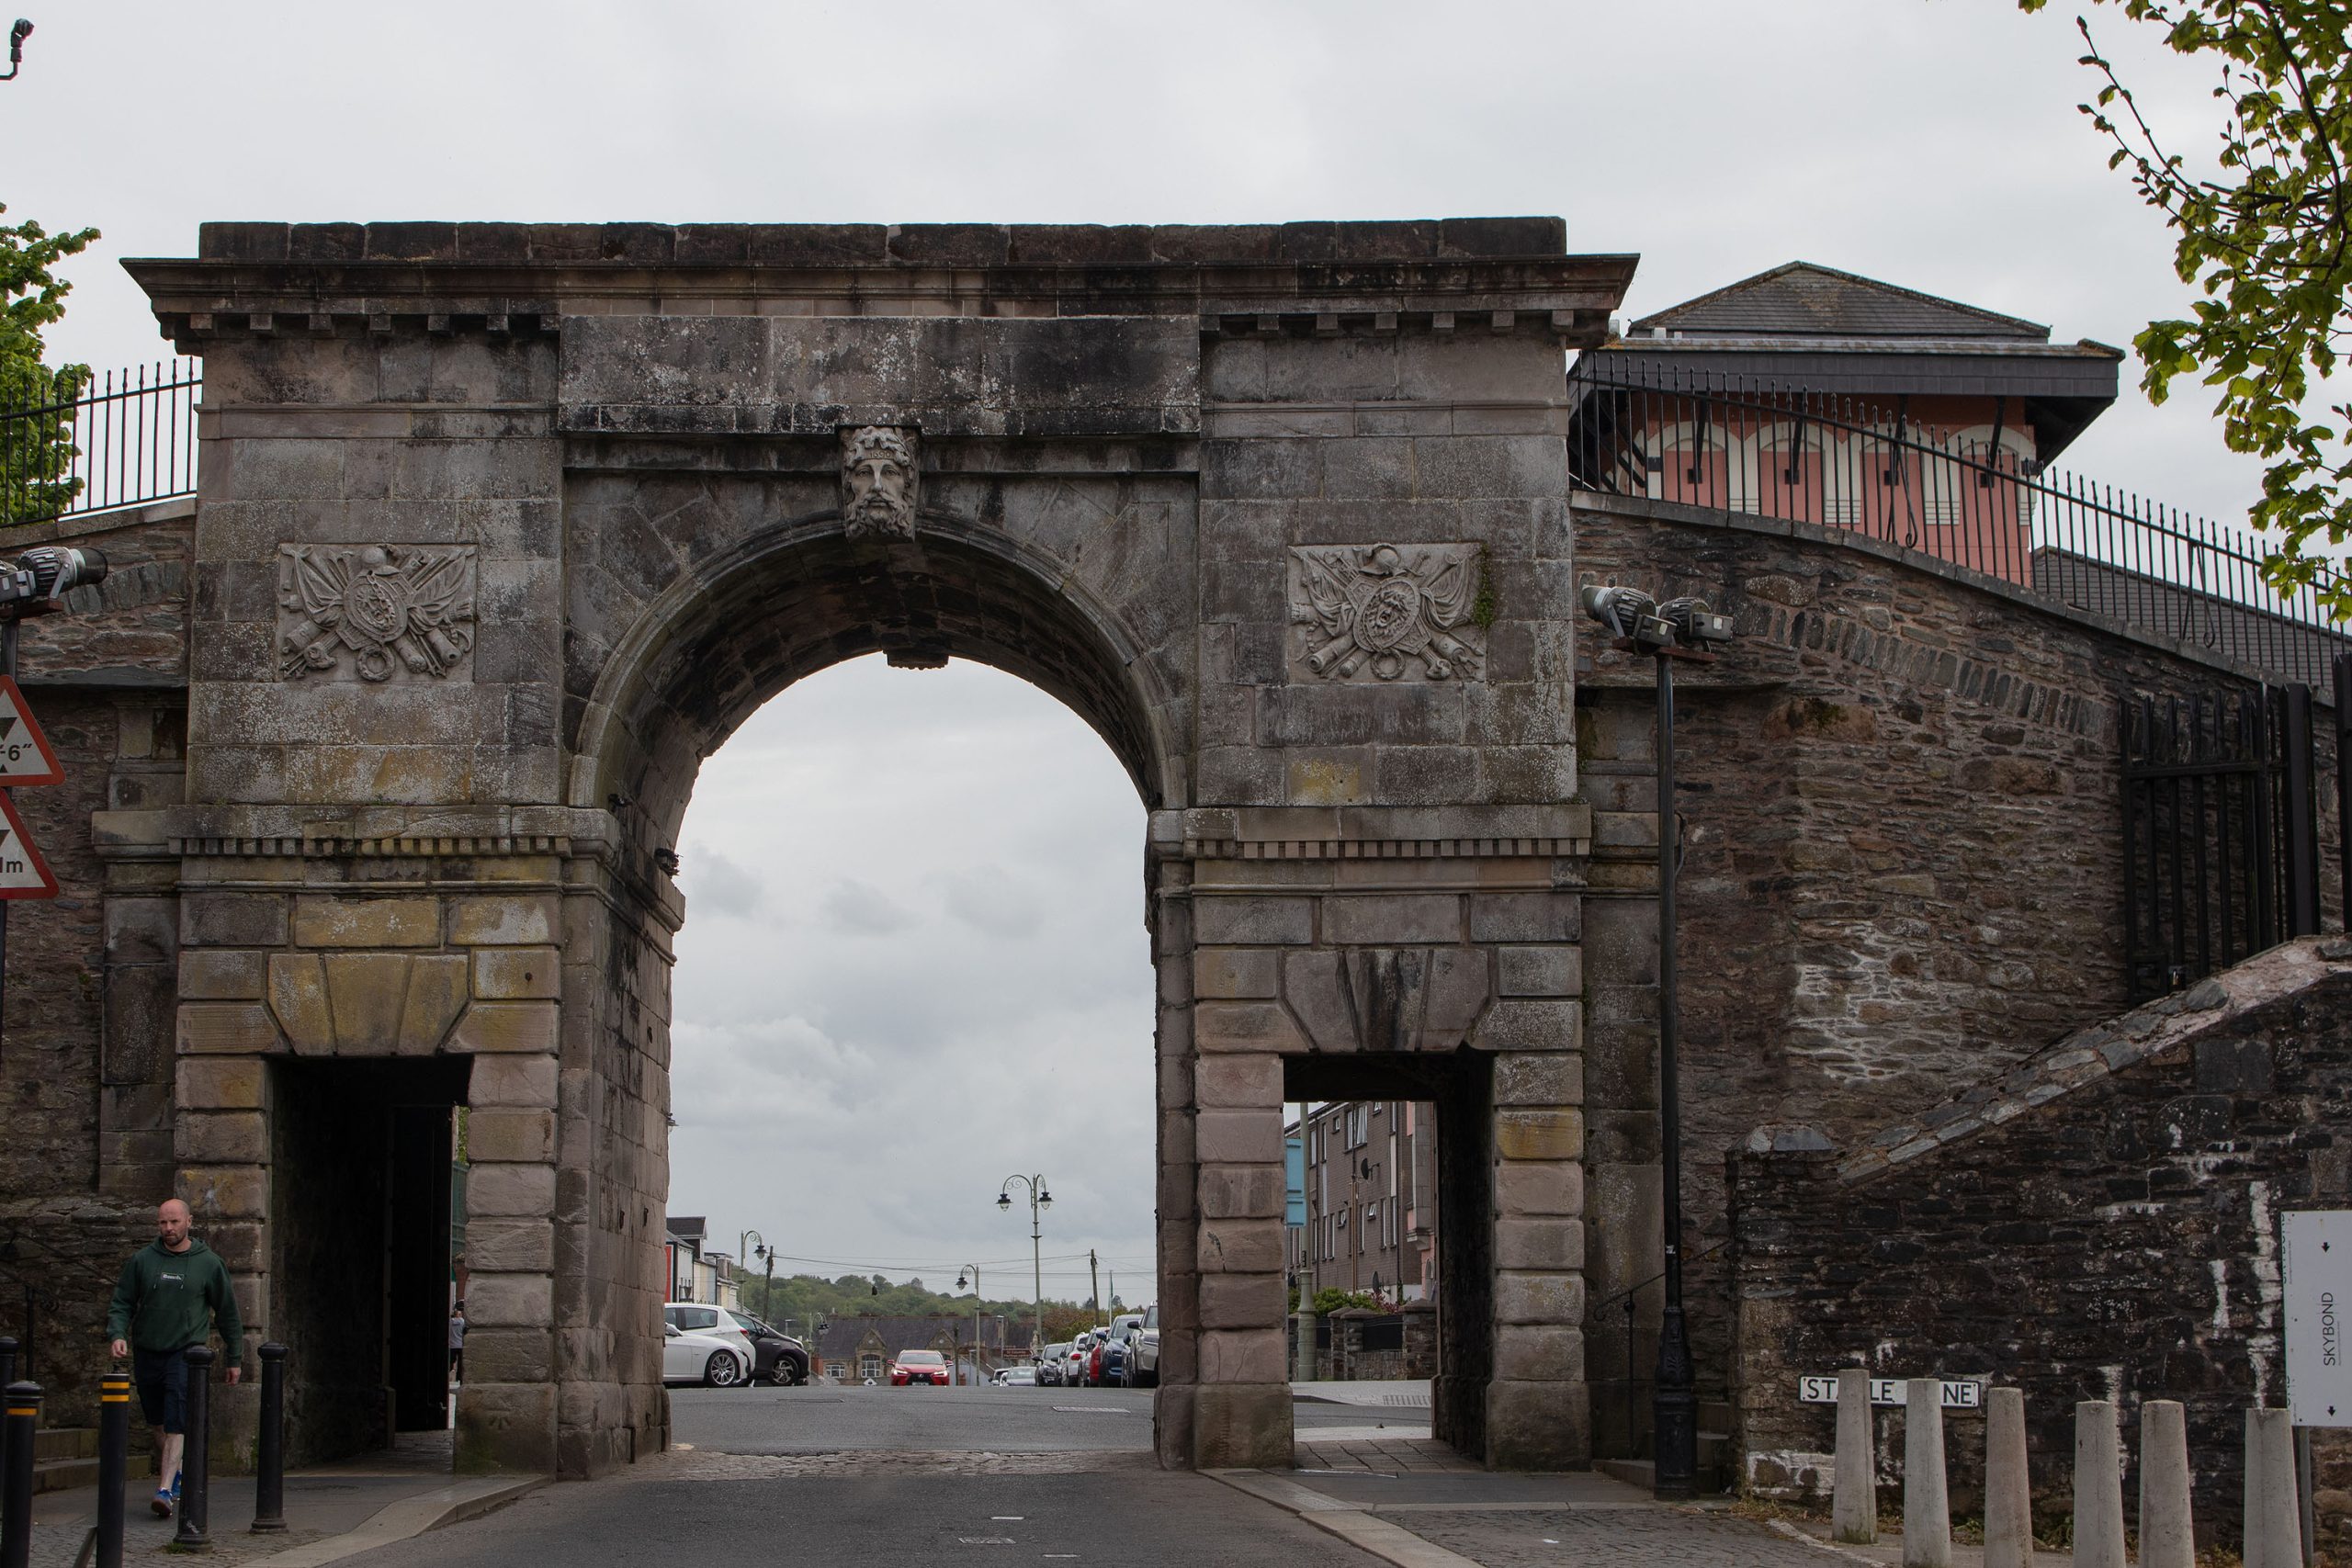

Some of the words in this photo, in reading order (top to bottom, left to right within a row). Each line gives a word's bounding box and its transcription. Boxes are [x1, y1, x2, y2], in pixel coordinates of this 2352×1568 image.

[869, 450, 891, 458] 1690
[2321, 1292, 2336, 1366] SKYBOND
[1807, 1379, 1893, 1401] STLE
